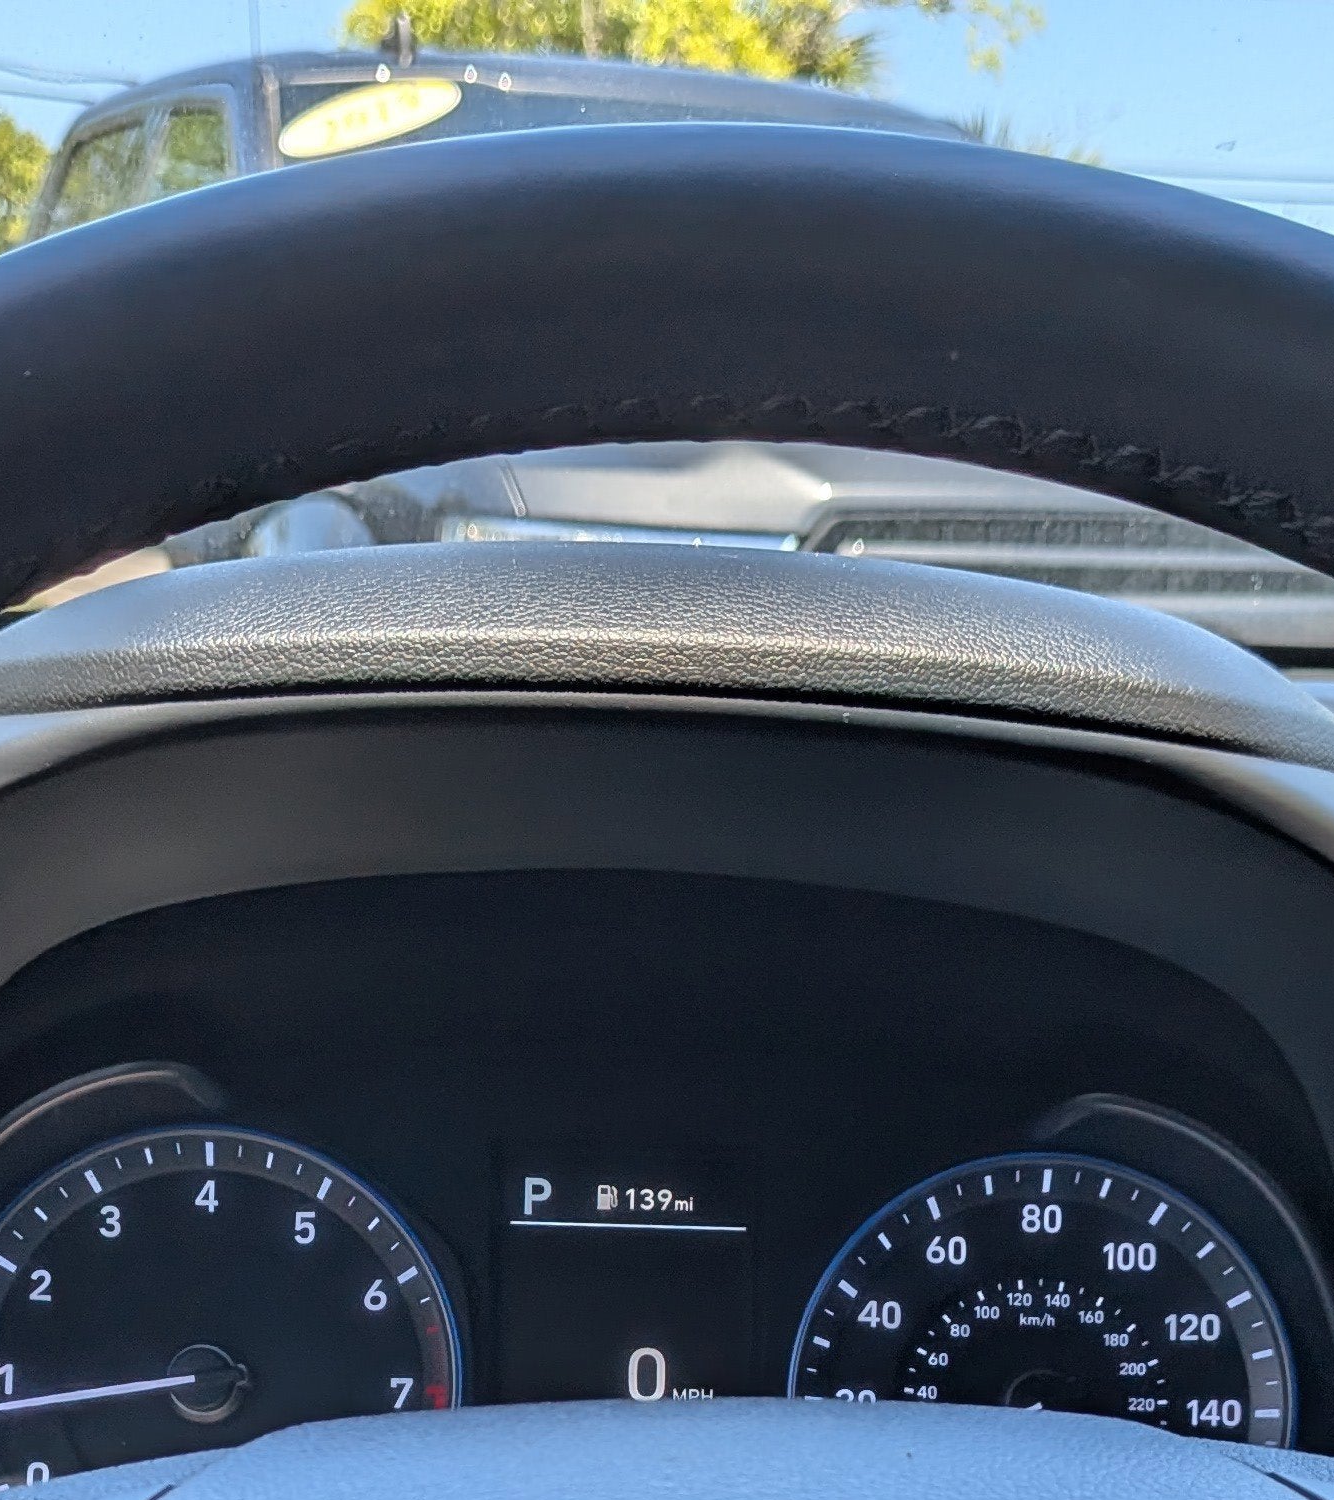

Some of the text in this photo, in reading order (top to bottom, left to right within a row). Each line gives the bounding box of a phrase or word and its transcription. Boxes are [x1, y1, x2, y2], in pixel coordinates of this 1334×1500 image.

[195, 1180, 218, 1212] 4
[524, 1177, 552, 1215] P
[99, 1205, 122, 1238] 3
[294, 1211, 316, 1244] 5
[1021, 1204, 1063, 1234] 80
[926, 1236, 968, 1265] 60
[1103, 1243, 1157, 1271] 100
[29, 1269, 52, 1302] 2
[364, 1279, 388, 1311] 6
[1007, 1292, 1032, 1307] 120
[973, 1305, 1000, 1320] 100
[1044, 1293, 1071, 1308] 140
[857, 1301, 902, 1330] 40
[1019, 1312, 1056, 1327] km/h
[1078, 1310, 1105, 1324] 160
[1165, 1314, 1221, 1342] 120
[950, 1323, 971, 1338] 80
[1103, 1333, 1129, 1347] 180
[927, 1352, 949, 1367] 60
[1119, 1362, 1147, 1376] 200
[628, 1347, 714, 1401] 0 MPH
[390, 1377, 414, 1408] 7
[916, 1385, 938, 1400] 40
[1128, 1398, 1156, 1412] 220
[1186, 1399, 1242, 1427] 140
[27, 1461, 50, 1487] 0
